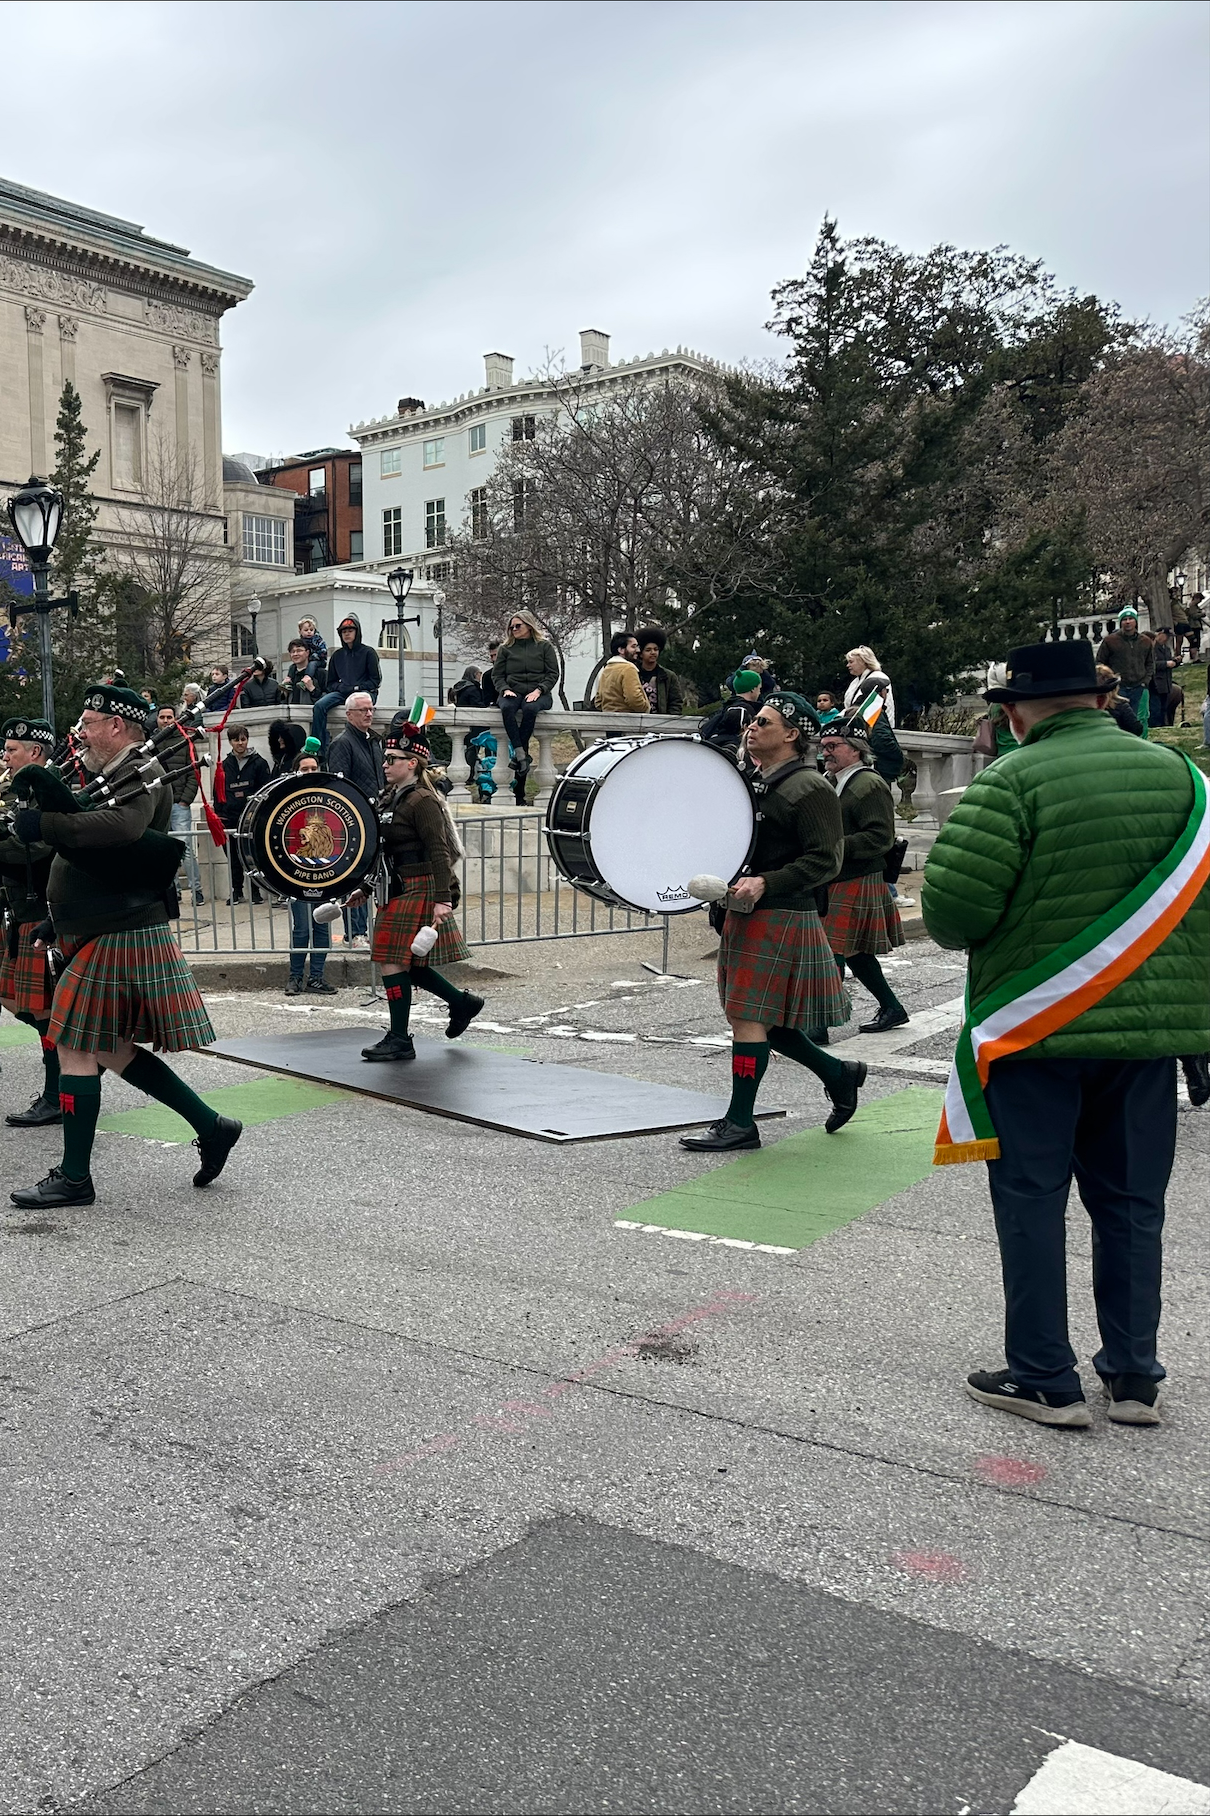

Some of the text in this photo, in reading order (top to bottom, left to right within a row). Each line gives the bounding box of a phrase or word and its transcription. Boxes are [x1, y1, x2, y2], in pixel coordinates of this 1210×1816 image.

[11, 562, 29, 571] ART
[276, 795, 355, 827] WASHINGTON SCOTTISH
[293, 869, 335, 880] PIPE BAND
[662, 892, 689, 900] REMO
